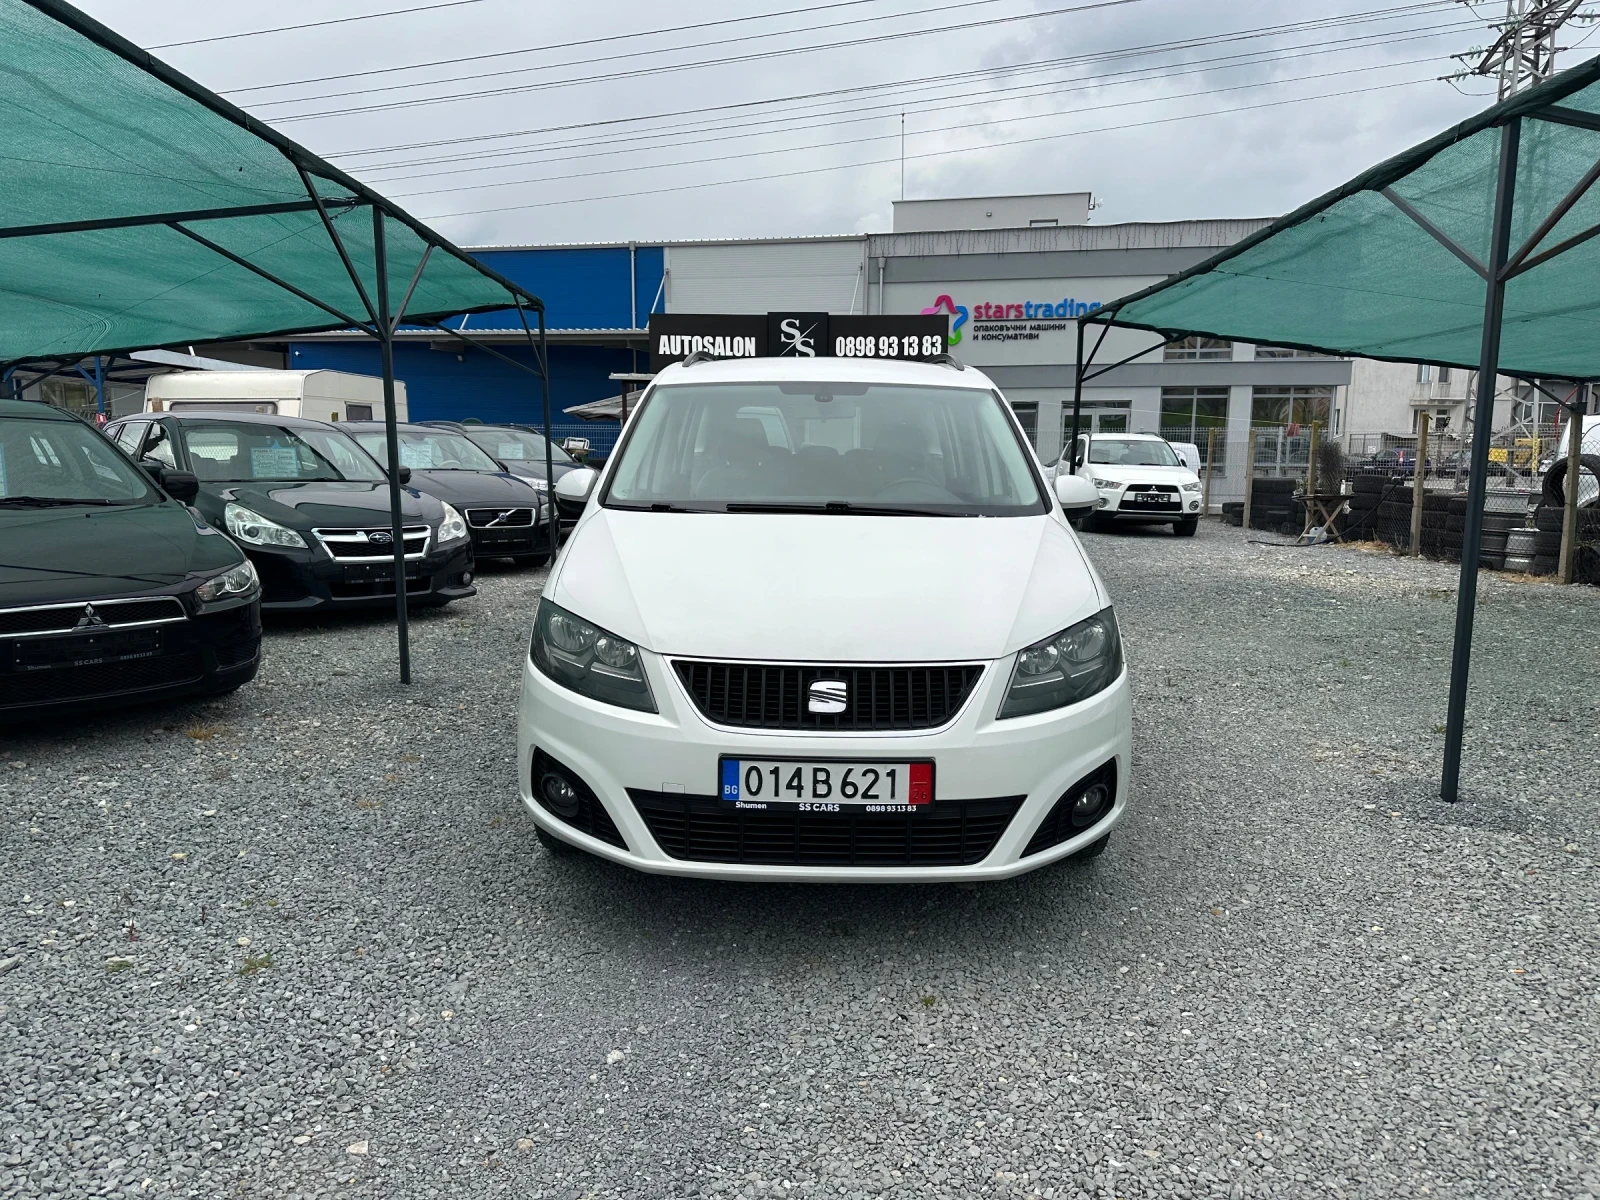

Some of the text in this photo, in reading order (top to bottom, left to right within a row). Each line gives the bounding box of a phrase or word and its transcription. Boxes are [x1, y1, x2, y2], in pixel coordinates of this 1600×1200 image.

[973, 322, 1067, 333] опаковъчни машини
[972, 332, 1040, 342] и консумативи
[658, 334, 756, 357] AUTOSALON
[835, 334, 942, 357] 0898 93 13 83
[724, 785, 738, 795] BG
[735, 801, 917, 812] Shumen SS CARS 0898 93 13 83
